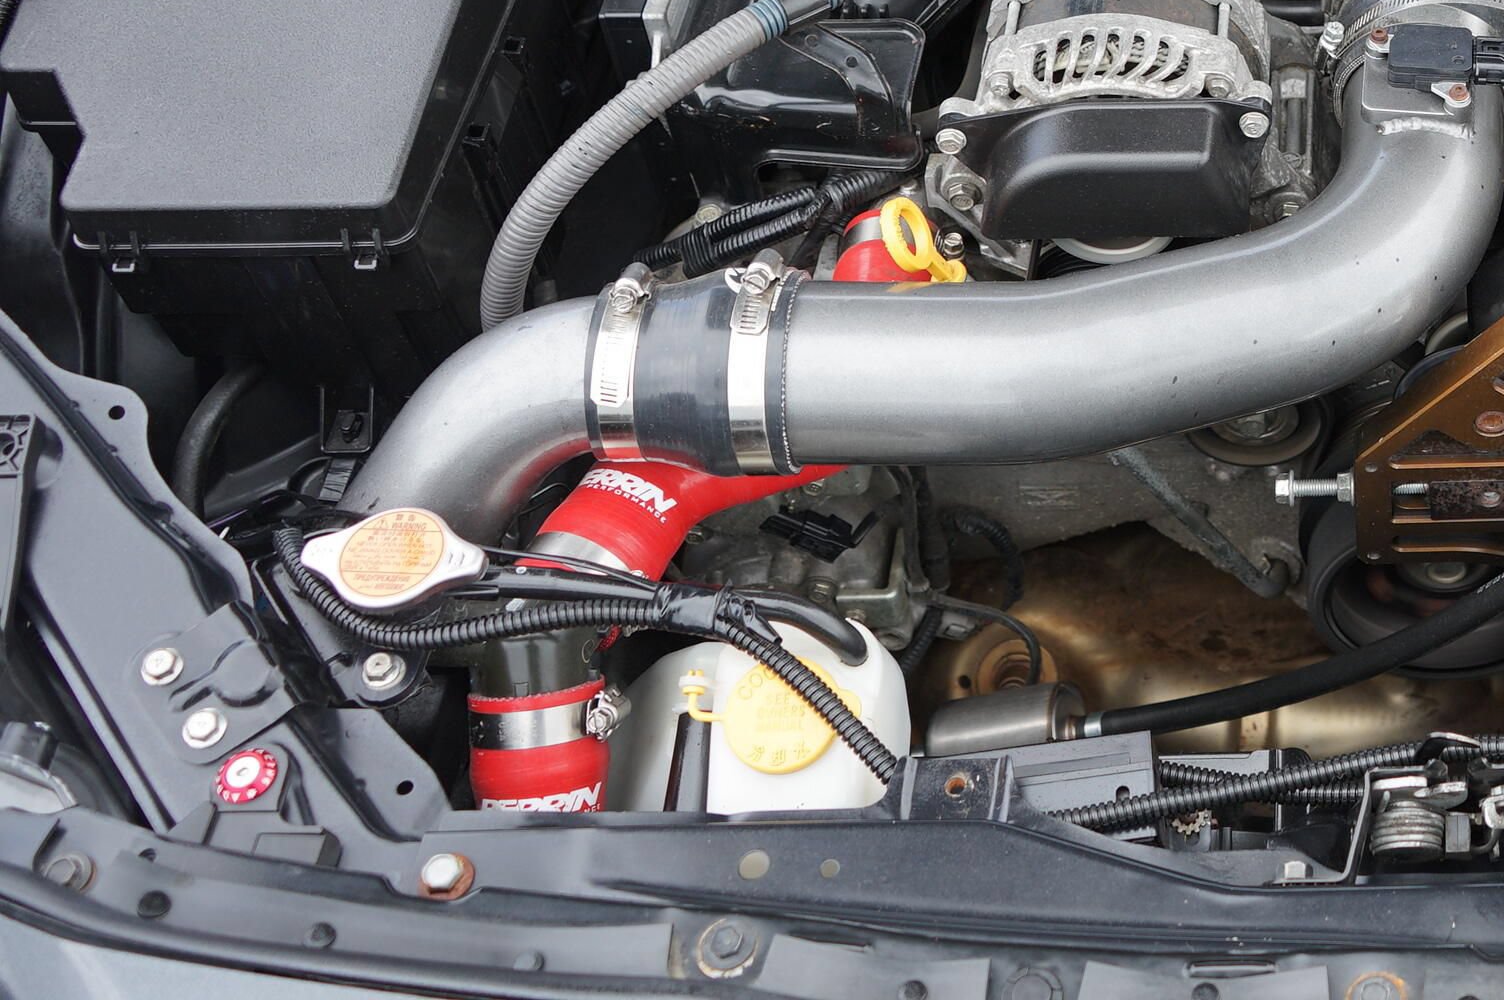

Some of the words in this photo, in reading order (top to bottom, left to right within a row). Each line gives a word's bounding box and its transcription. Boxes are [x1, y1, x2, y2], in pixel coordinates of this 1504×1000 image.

[579, 468, 677, 513] ERRIN
[586, 484, 667, 523] PERFORMANCE
[391, 522, 427, 530] WARNING
